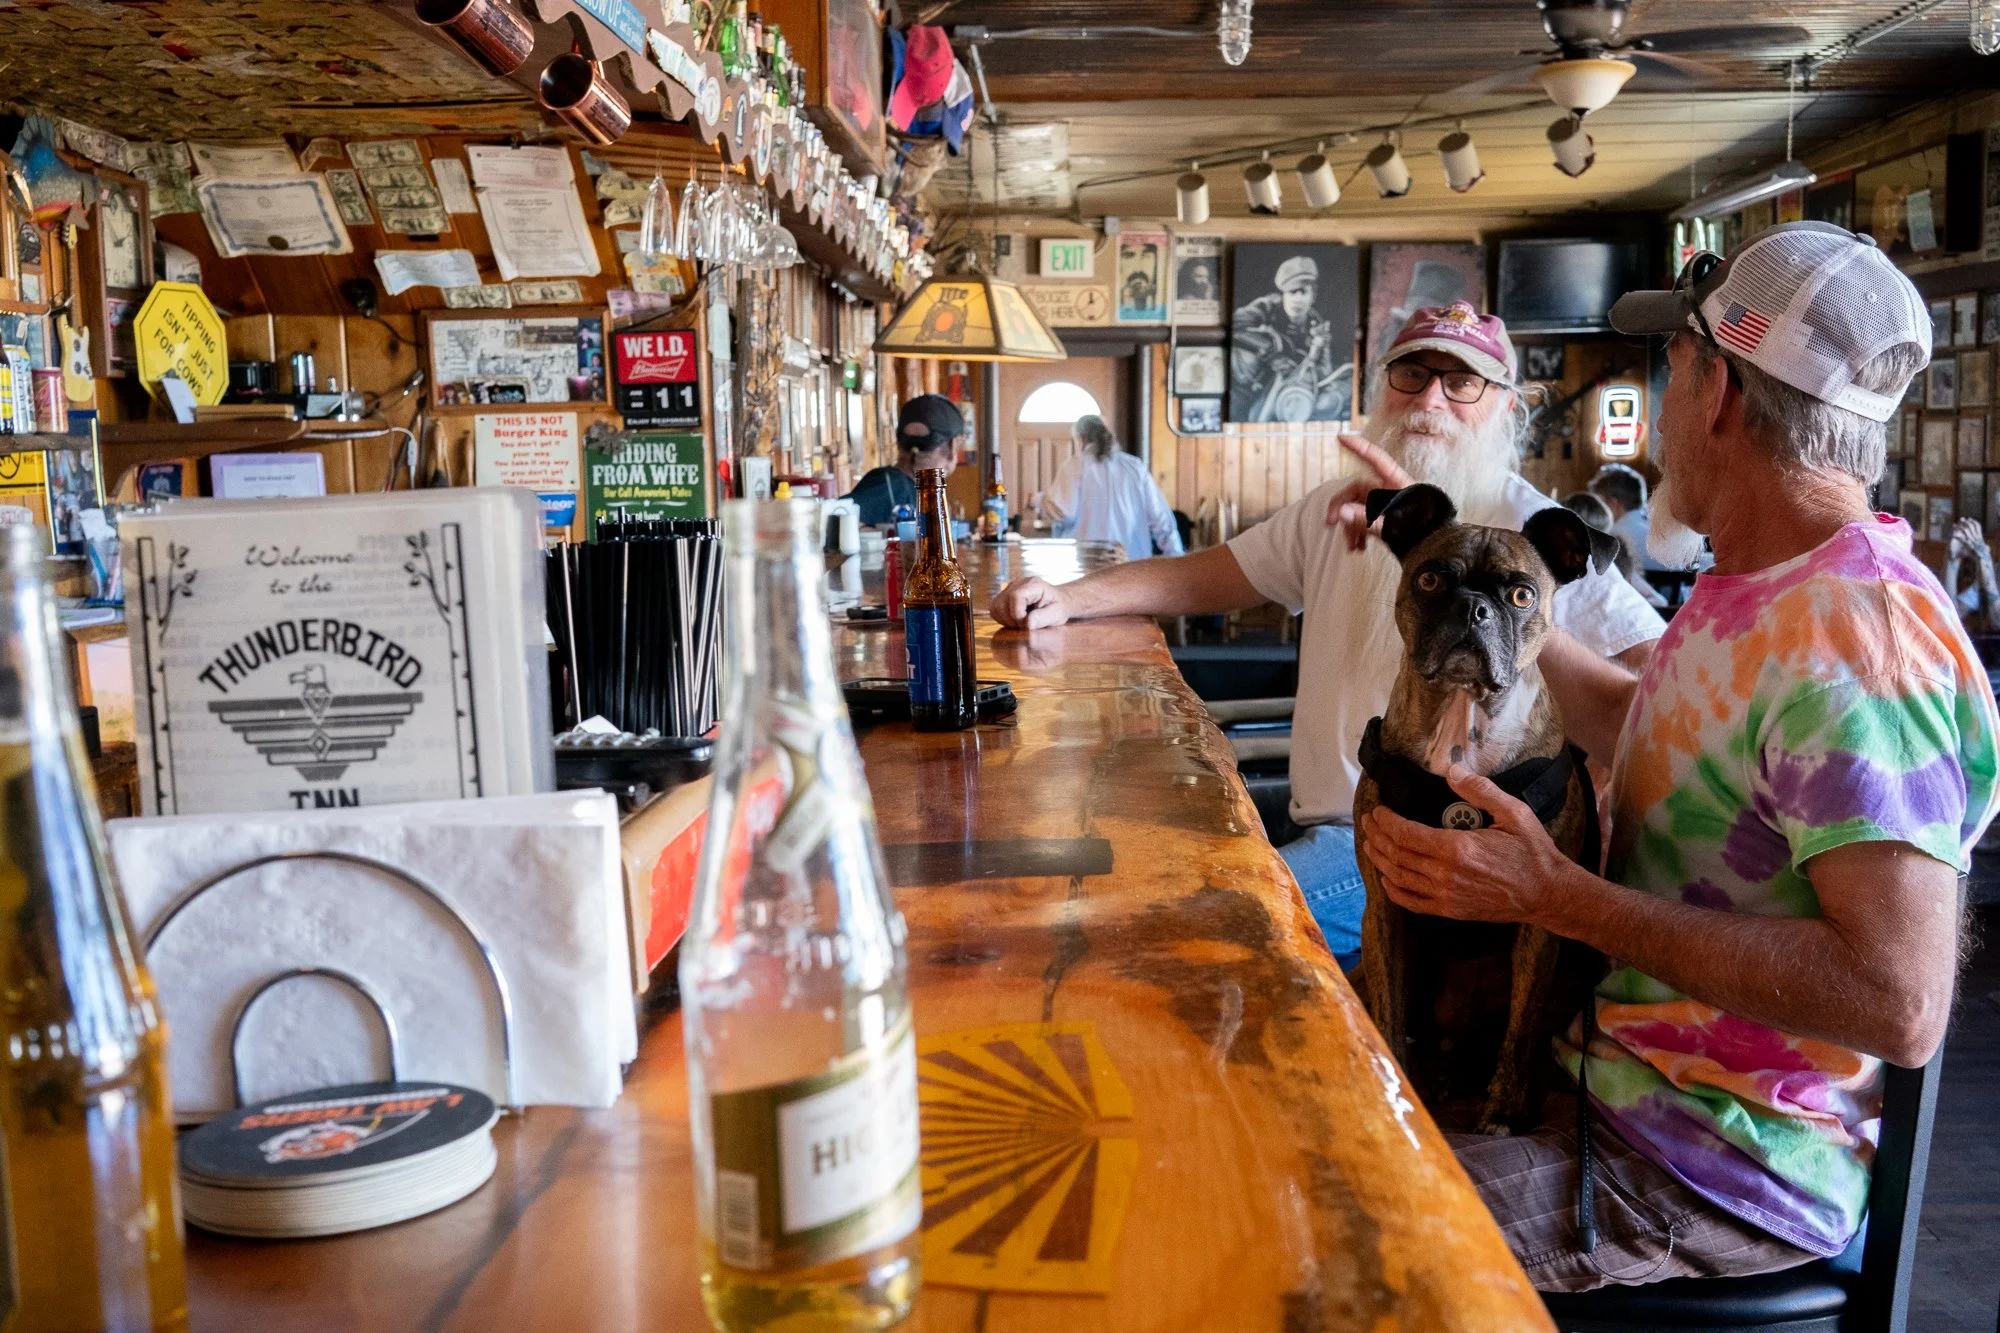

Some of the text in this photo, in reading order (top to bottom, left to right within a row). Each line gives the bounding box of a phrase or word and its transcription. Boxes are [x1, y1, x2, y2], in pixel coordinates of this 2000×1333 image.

[1051, 245, 1086, 271] EXIT
[181, 301, 217, 354] TIPPING
[162, 308, 214, 380] ISN'T JUST
[623, 335, 688, 358] WE I.D.
[153, 328, 204, 398] FOR COWS
[493, 427, 569, 438] Burger King
[495, 415, 564, 426] THIS IS NOT
[592, 464, 700, 486] FROM WIFE
[603, 486, 617, 498] Bar
[617, 486, 634, 498] Call
[671, 485, 693, 498] Rates
[244, 543, 356, 568] Welcome
[269, 573, 335, 595] to the
[198, 618, 422, 694] THUNDERBIRD
